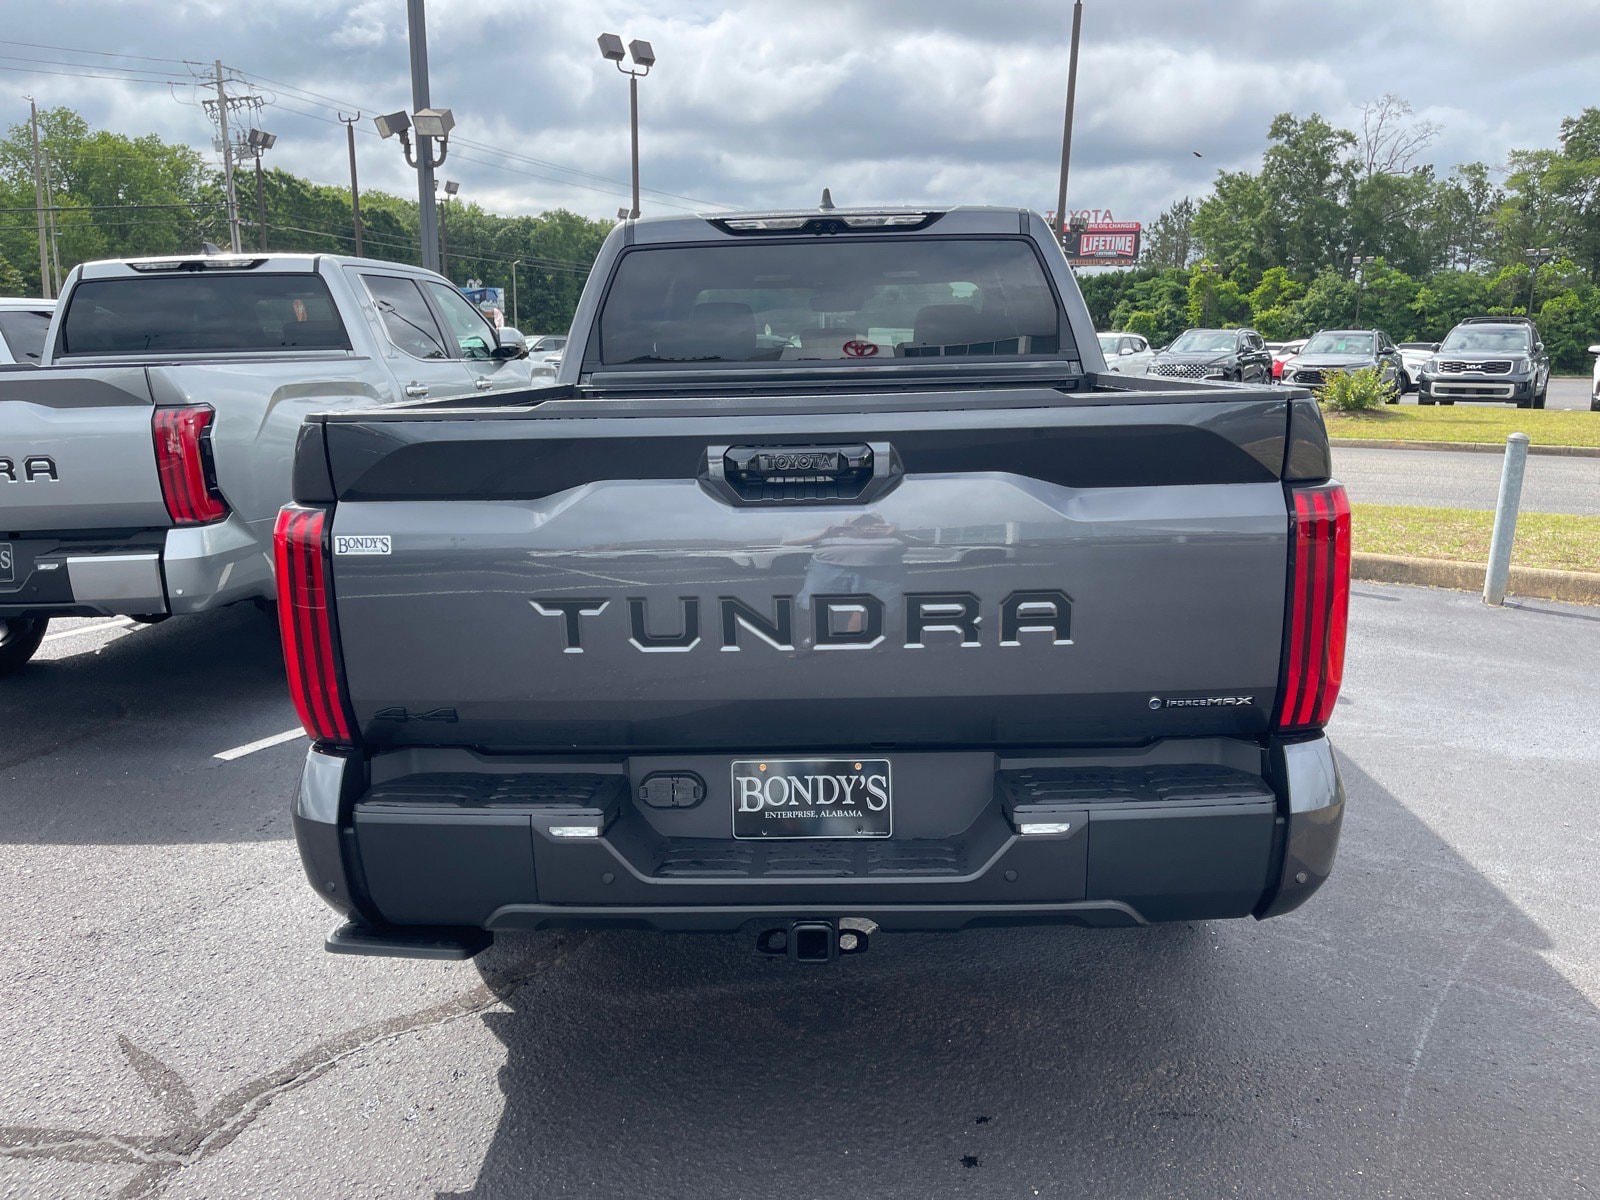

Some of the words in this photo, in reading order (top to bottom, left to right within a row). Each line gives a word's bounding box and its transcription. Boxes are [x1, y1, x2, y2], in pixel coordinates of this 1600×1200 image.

[1082, 236, 1132, 252] LIFETIME
[765, 454, 832, 470] TOYOTA
[336, 537, 389, 553] BONDY'S
[528, 589, 1075, 654] TUNDRA
[735, 775, 888, 812] BONDY'S
[765, 811, 818, 819] ENTERPRISE,
[819, 810, 863, 818] ALABAMA
